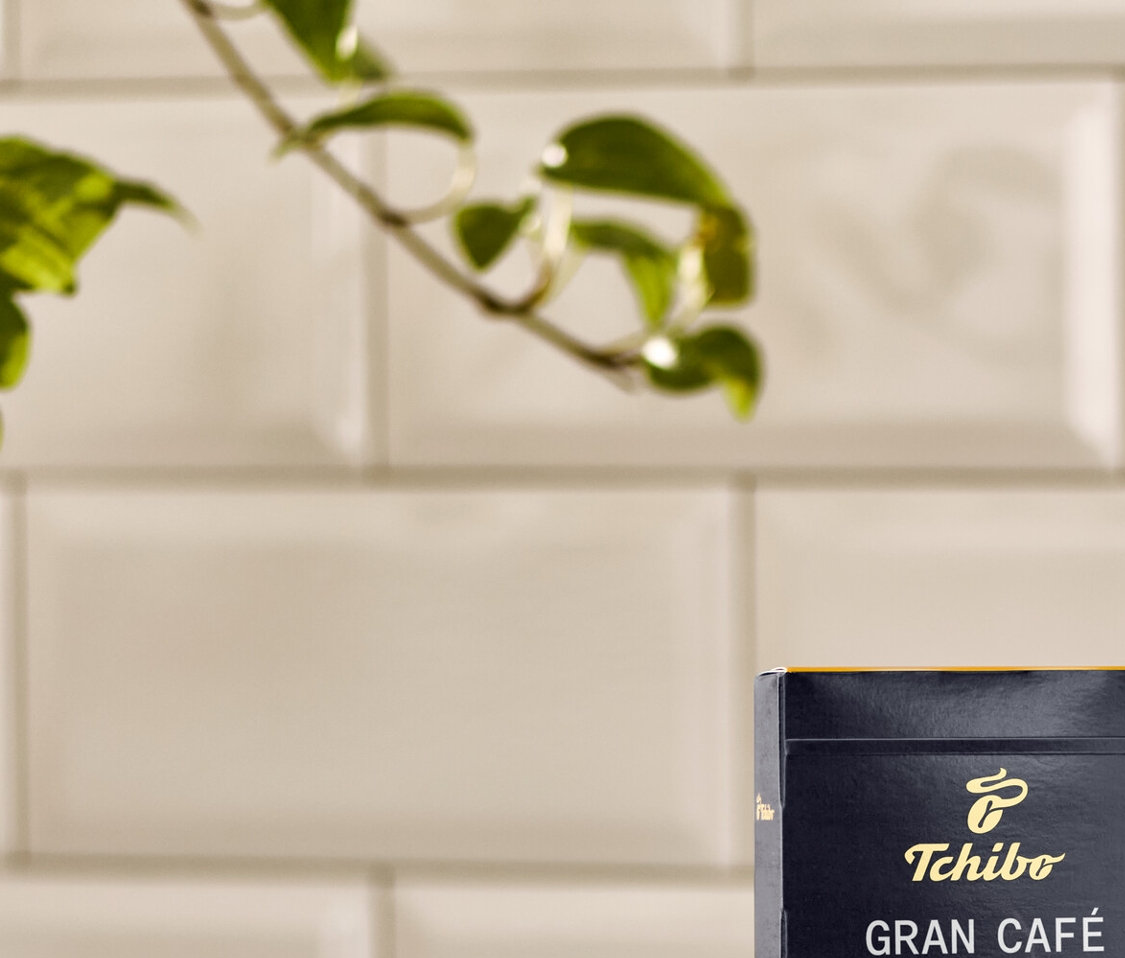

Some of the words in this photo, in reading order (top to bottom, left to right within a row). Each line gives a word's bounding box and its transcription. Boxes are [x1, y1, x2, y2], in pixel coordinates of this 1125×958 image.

[904, 842, 1066, 882] Tchibo
[865, 919, 976, 956] GRAN
[997, 907, 1105, 953] CAFÉ
